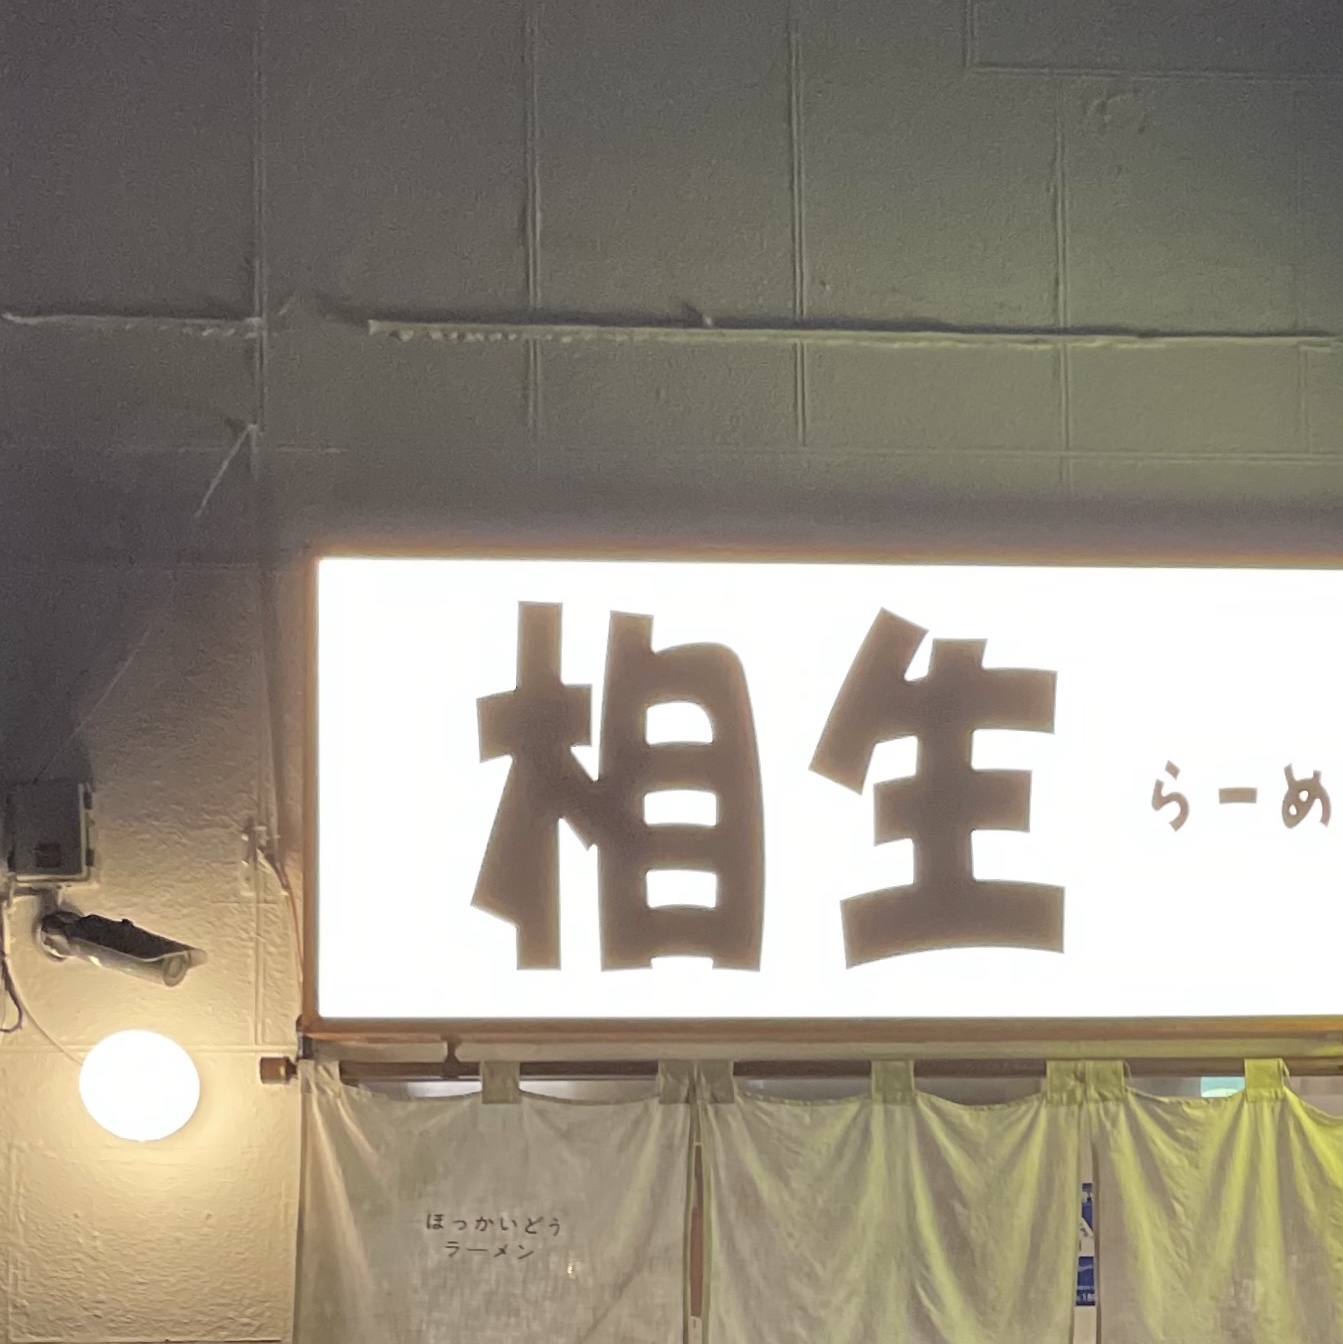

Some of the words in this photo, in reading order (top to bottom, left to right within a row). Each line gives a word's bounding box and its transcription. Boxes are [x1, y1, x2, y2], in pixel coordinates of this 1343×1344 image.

[471, 601, 1064, 971] 相生
[426, 1213, 561, 1236] ほっかいどう
[445, 1241, 535, 1260] ラーメン
